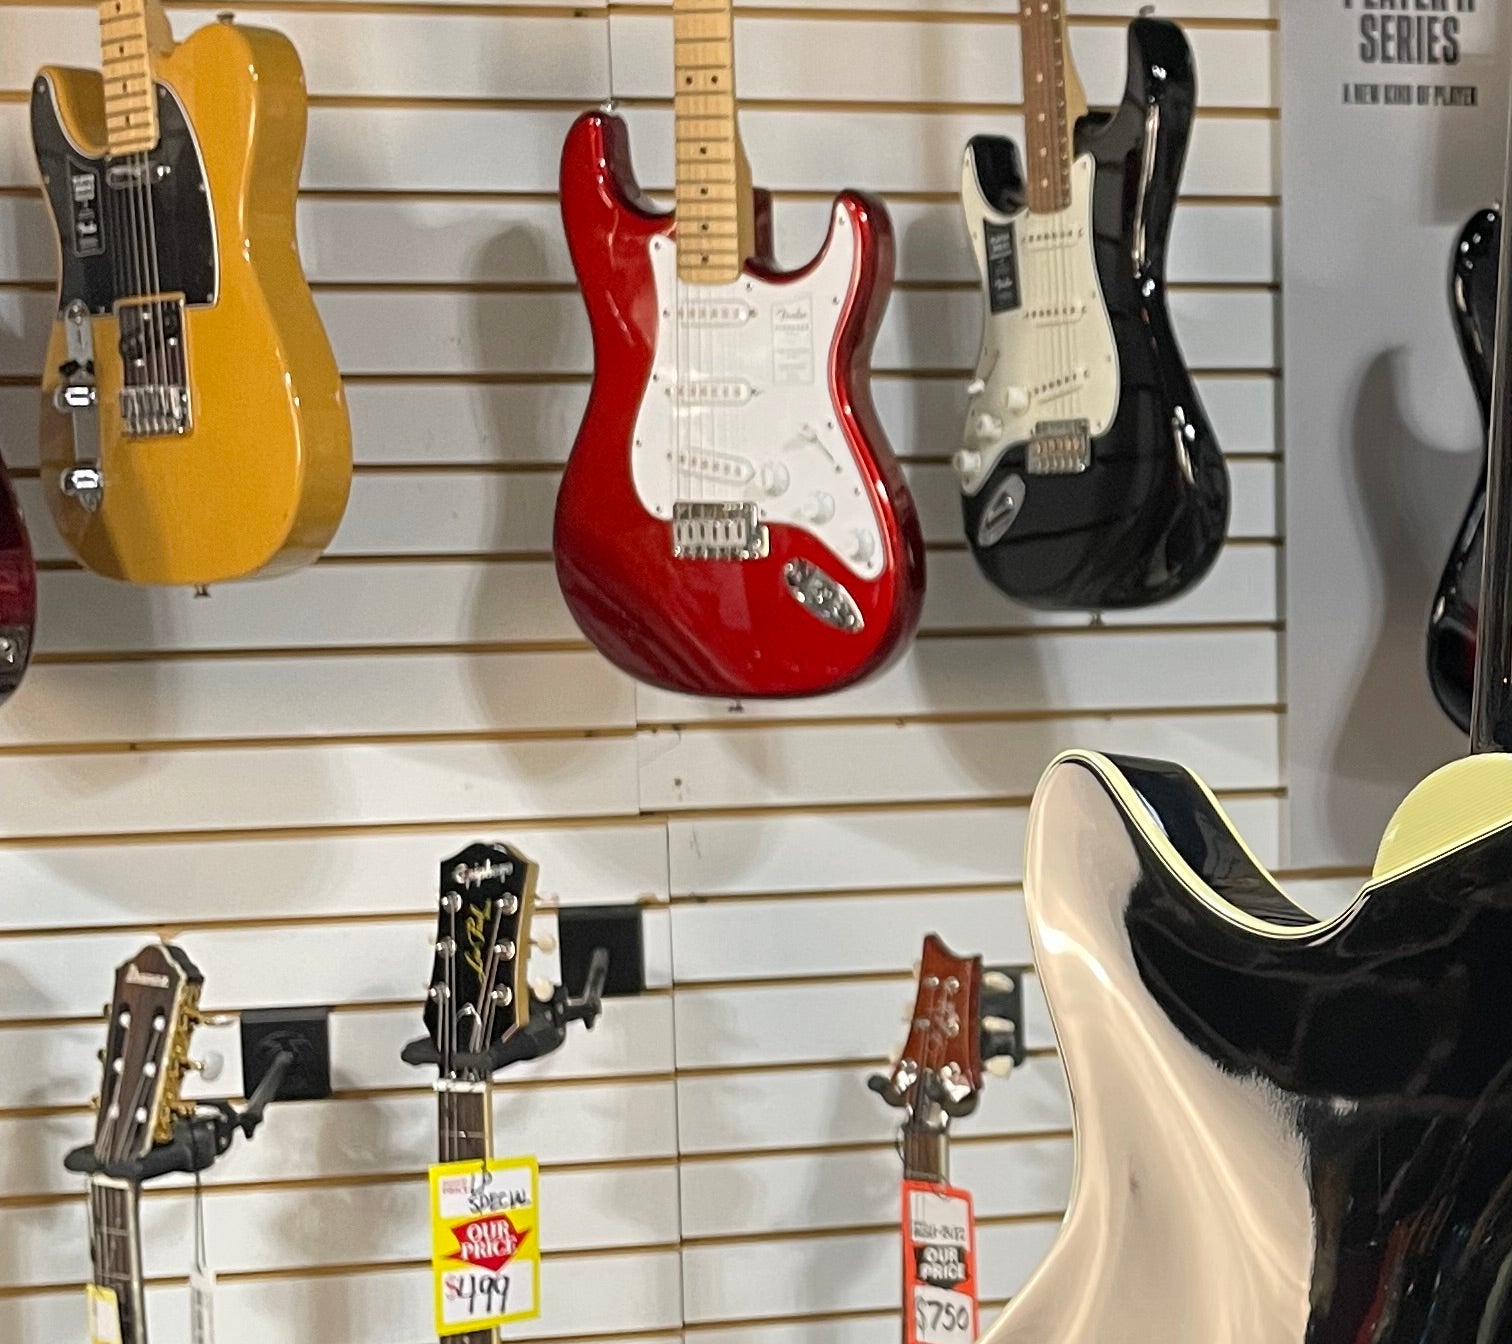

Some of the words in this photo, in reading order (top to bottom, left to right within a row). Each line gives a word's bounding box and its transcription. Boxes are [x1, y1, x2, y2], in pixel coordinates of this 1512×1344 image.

[1360, 13, 1460, 66] SERIES
[466, 1219, 511, 1243] OUR
[460, 1235, 518, 1261] PRICE
[923, 1247, 959, 1263] OUR
[919, 1261, 967, 1280] PRICE
[916, 1296, 969, 1339] $750
